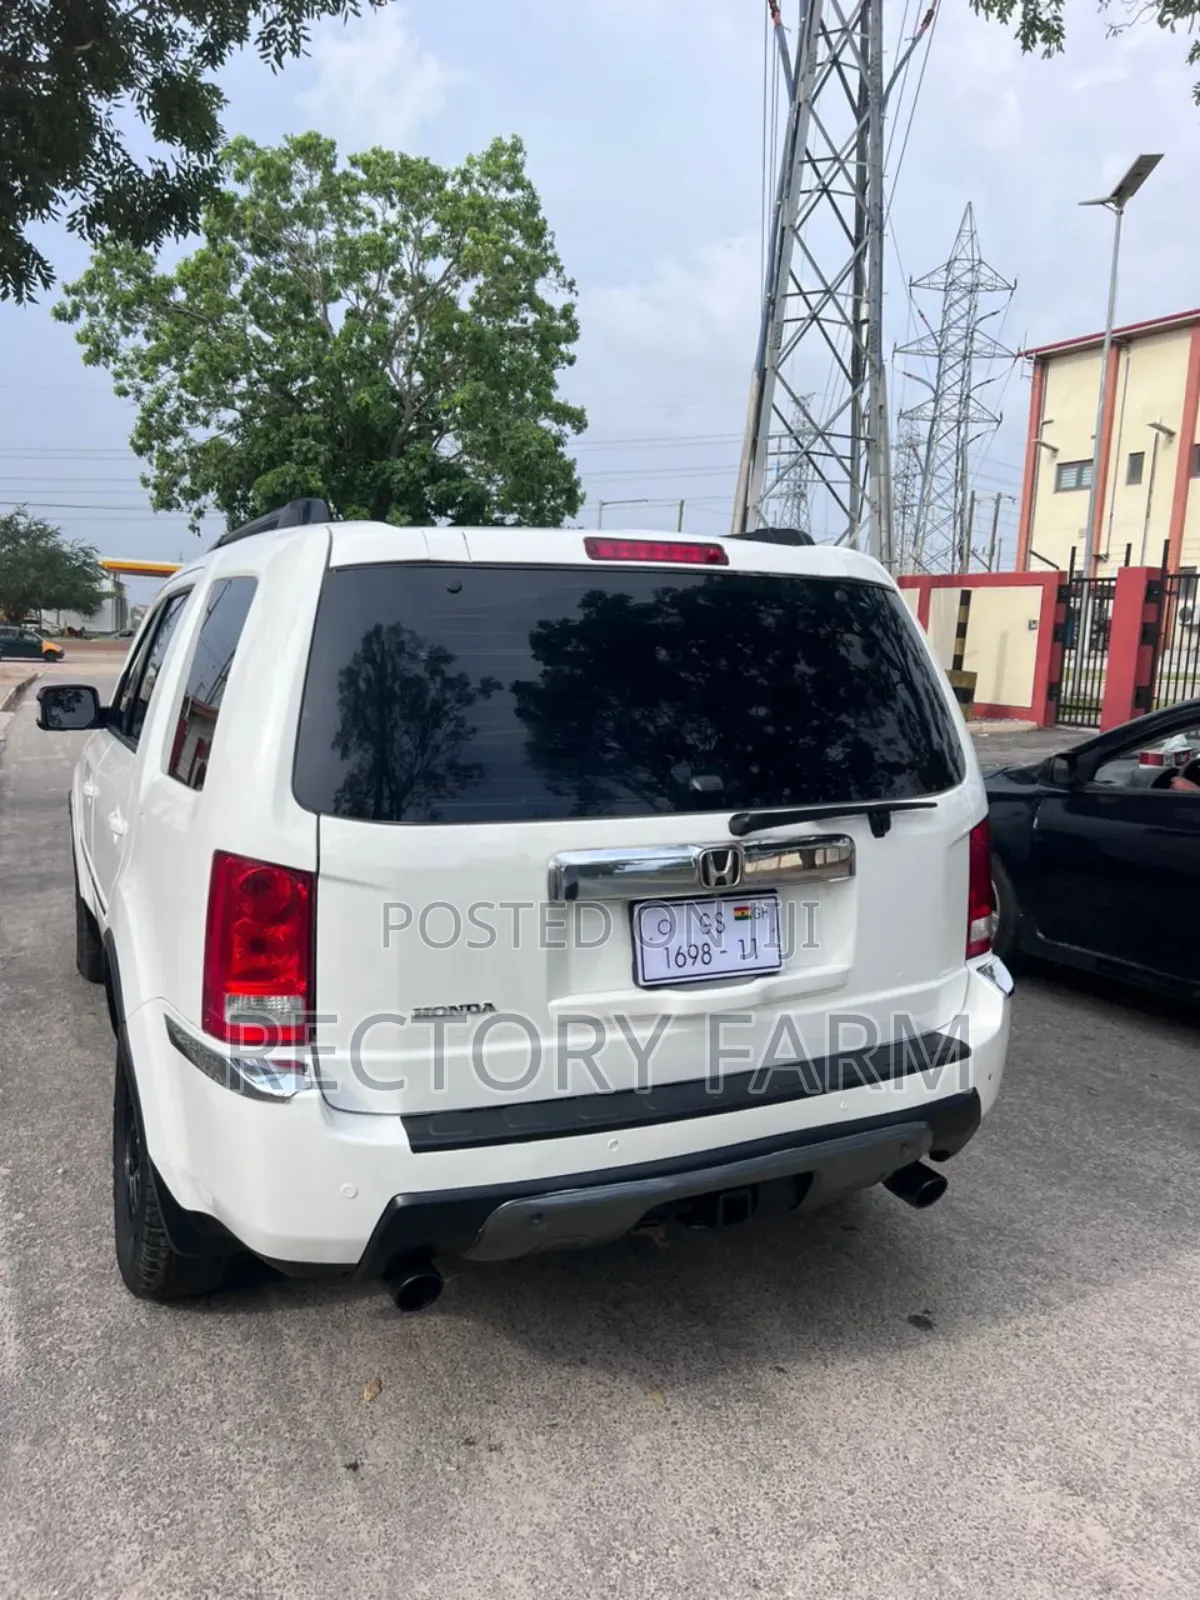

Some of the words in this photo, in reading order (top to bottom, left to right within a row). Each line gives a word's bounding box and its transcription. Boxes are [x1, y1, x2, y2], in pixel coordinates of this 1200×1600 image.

[700, 911, 725, 934] GS
[664, 942, 712, 968] 1698
[411, 1003, 498, 1018] HONDA
